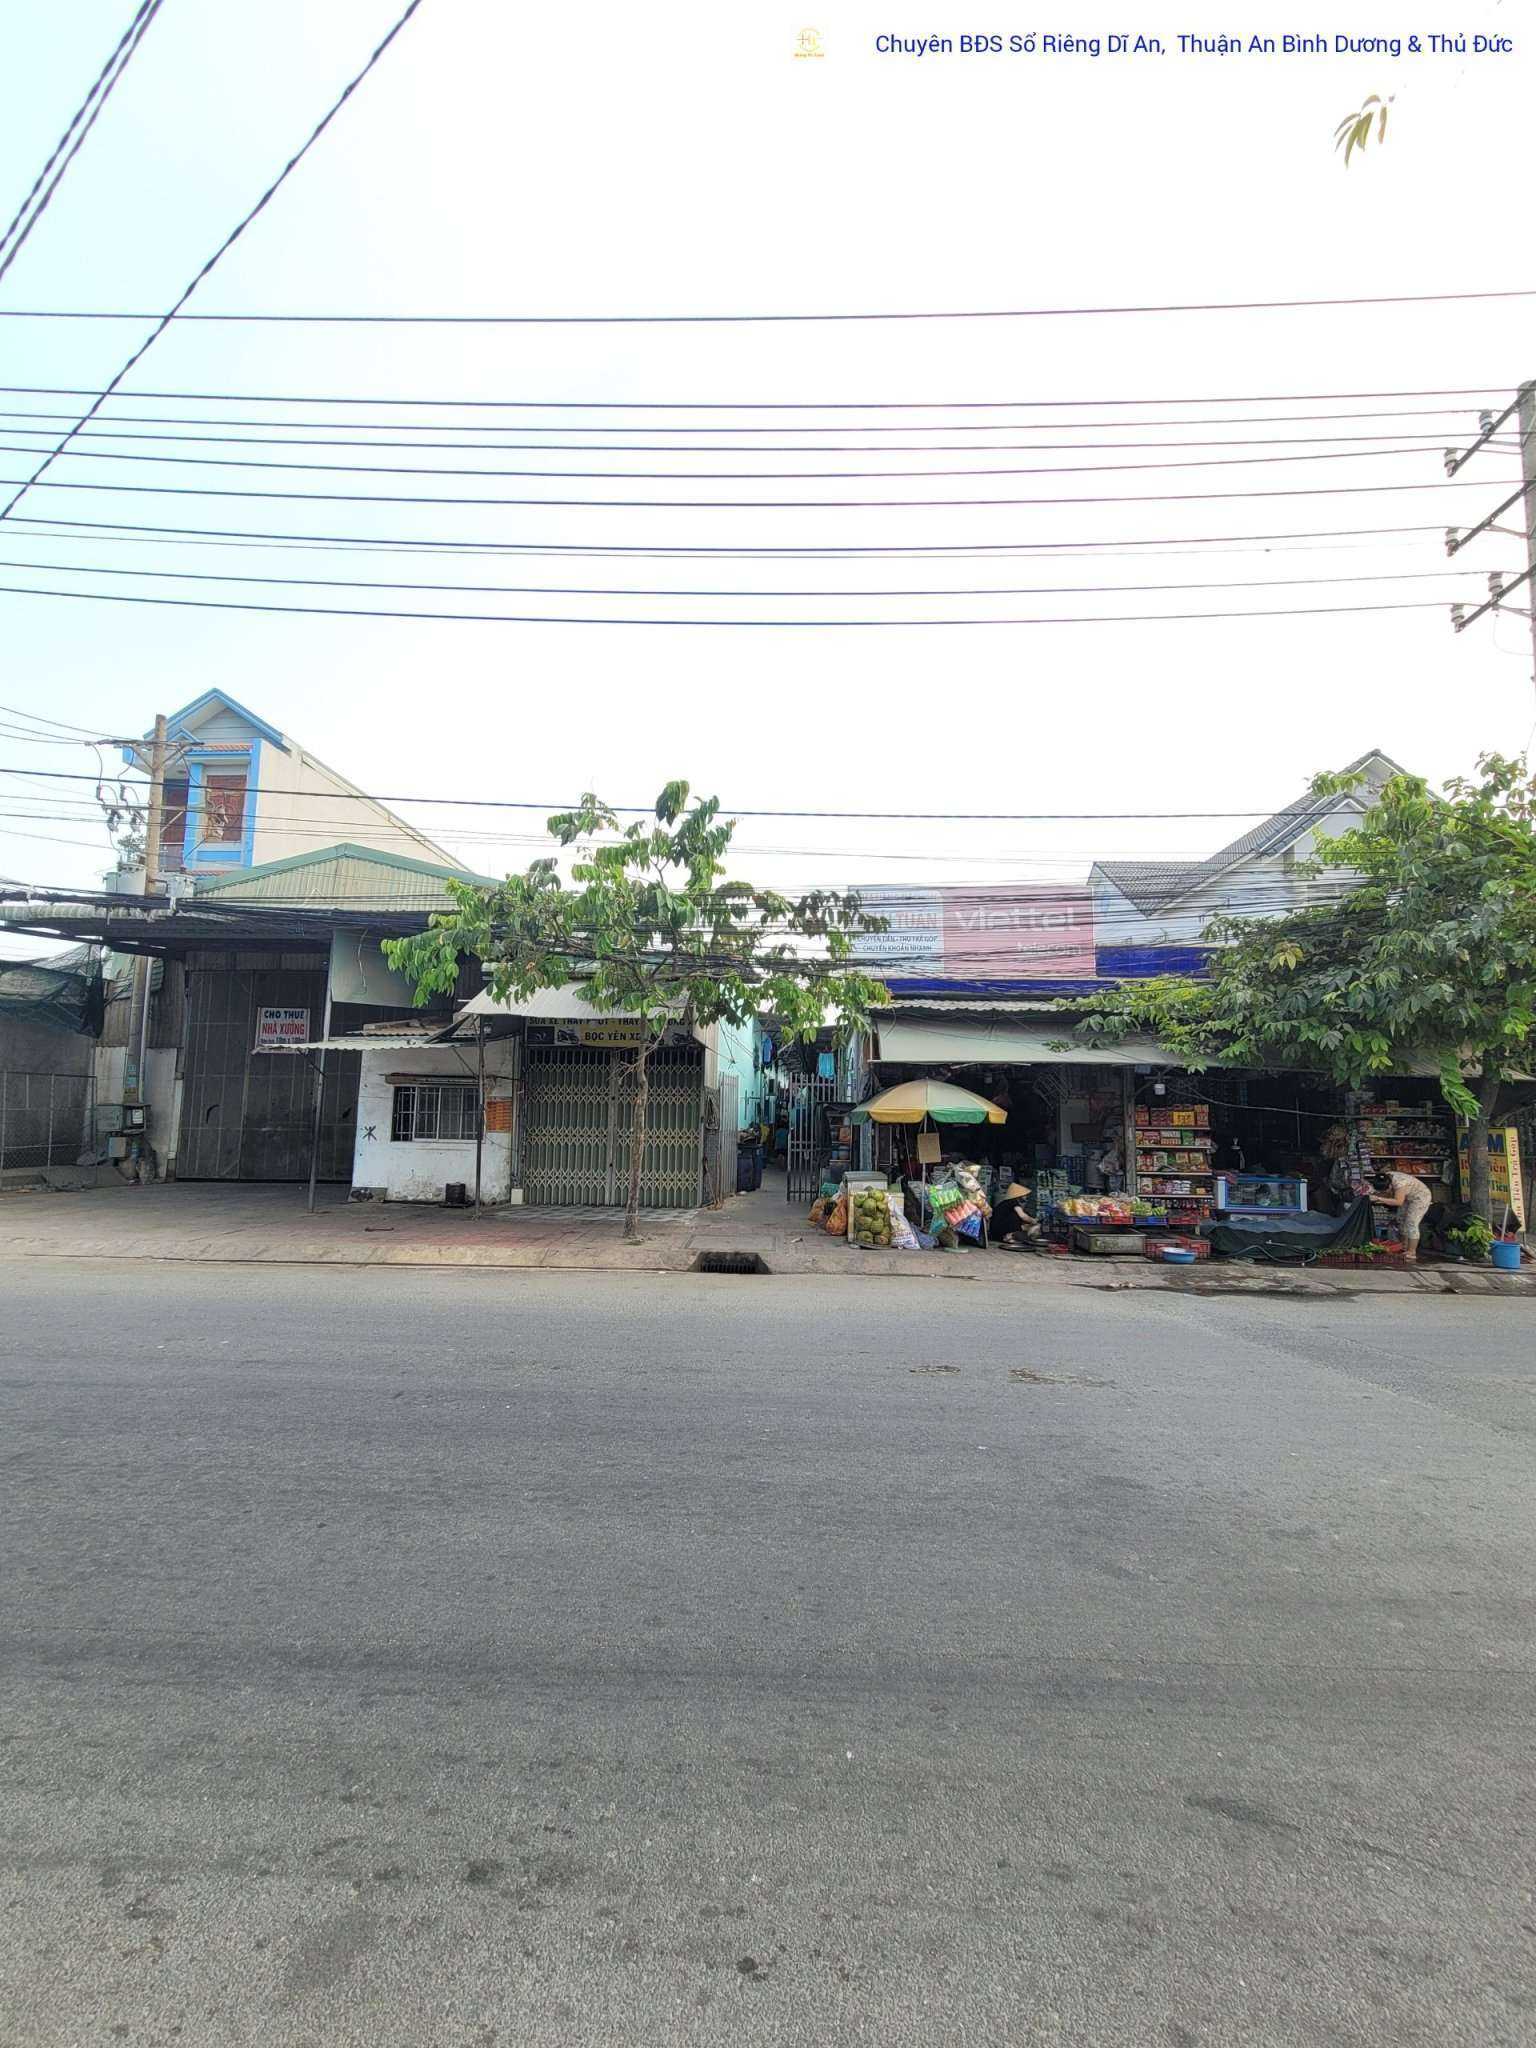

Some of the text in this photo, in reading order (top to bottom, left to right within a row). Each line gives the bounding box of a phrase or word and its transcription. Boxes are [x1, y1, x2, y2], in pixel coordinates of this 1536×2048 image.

[264, 1010, 281, 1019] CHO
[585, 1031, 605, 1042] BỌC
[1459, 1133, 1505, 1153] AM
